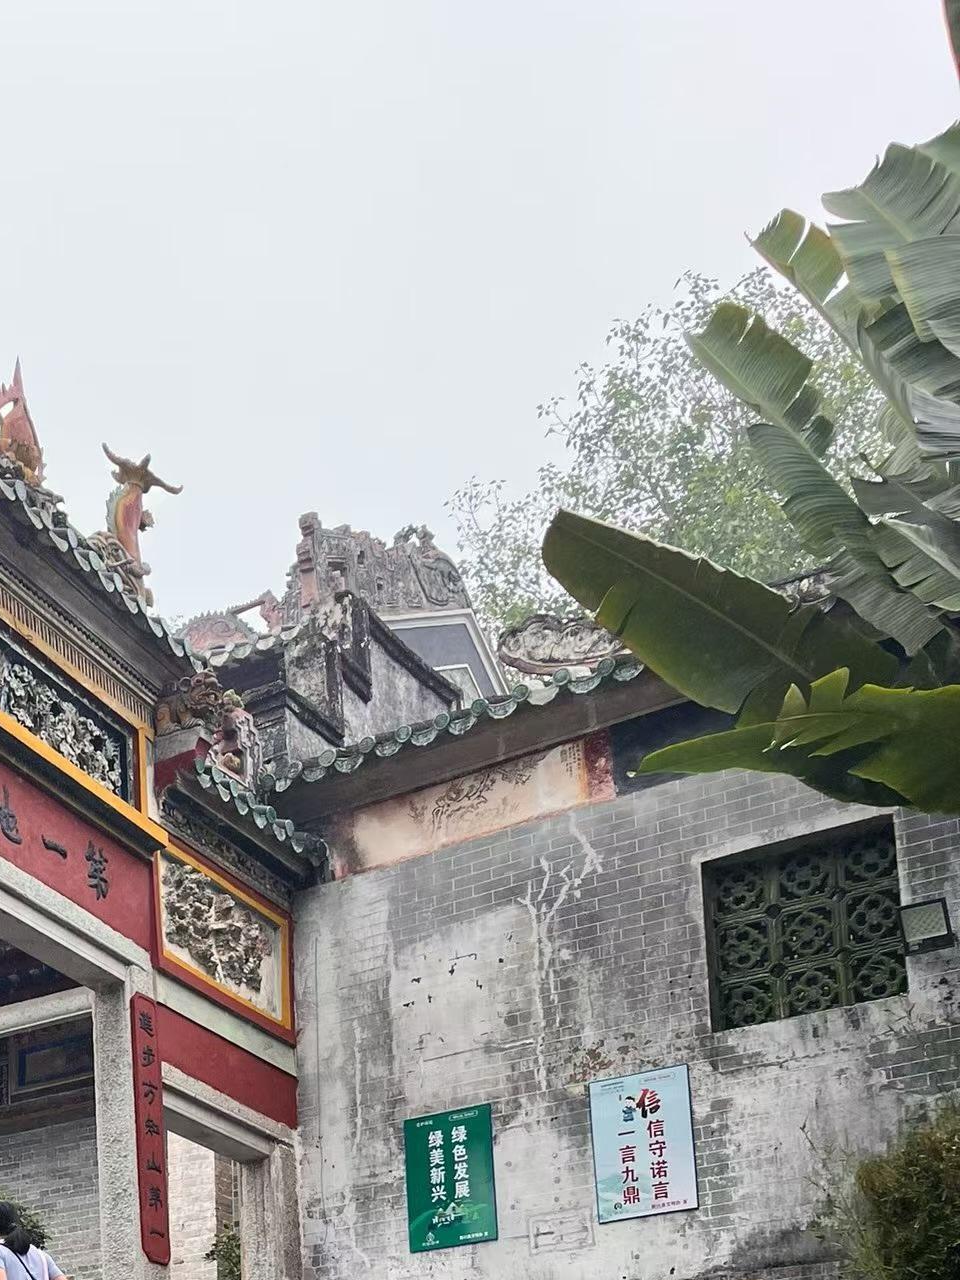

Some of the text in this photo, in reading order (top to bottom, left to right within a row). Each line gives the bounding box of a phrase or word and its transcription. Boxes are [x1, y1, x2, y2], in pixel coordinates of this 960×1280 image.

[428, 1130, 448, 1203] 绿美新兴
[451, 1124, 471, 1199] 绿色发展
[617, 1129, 641, 1205] 一言九鼎
[646, 1119, 670, 1201] 信守诺言
